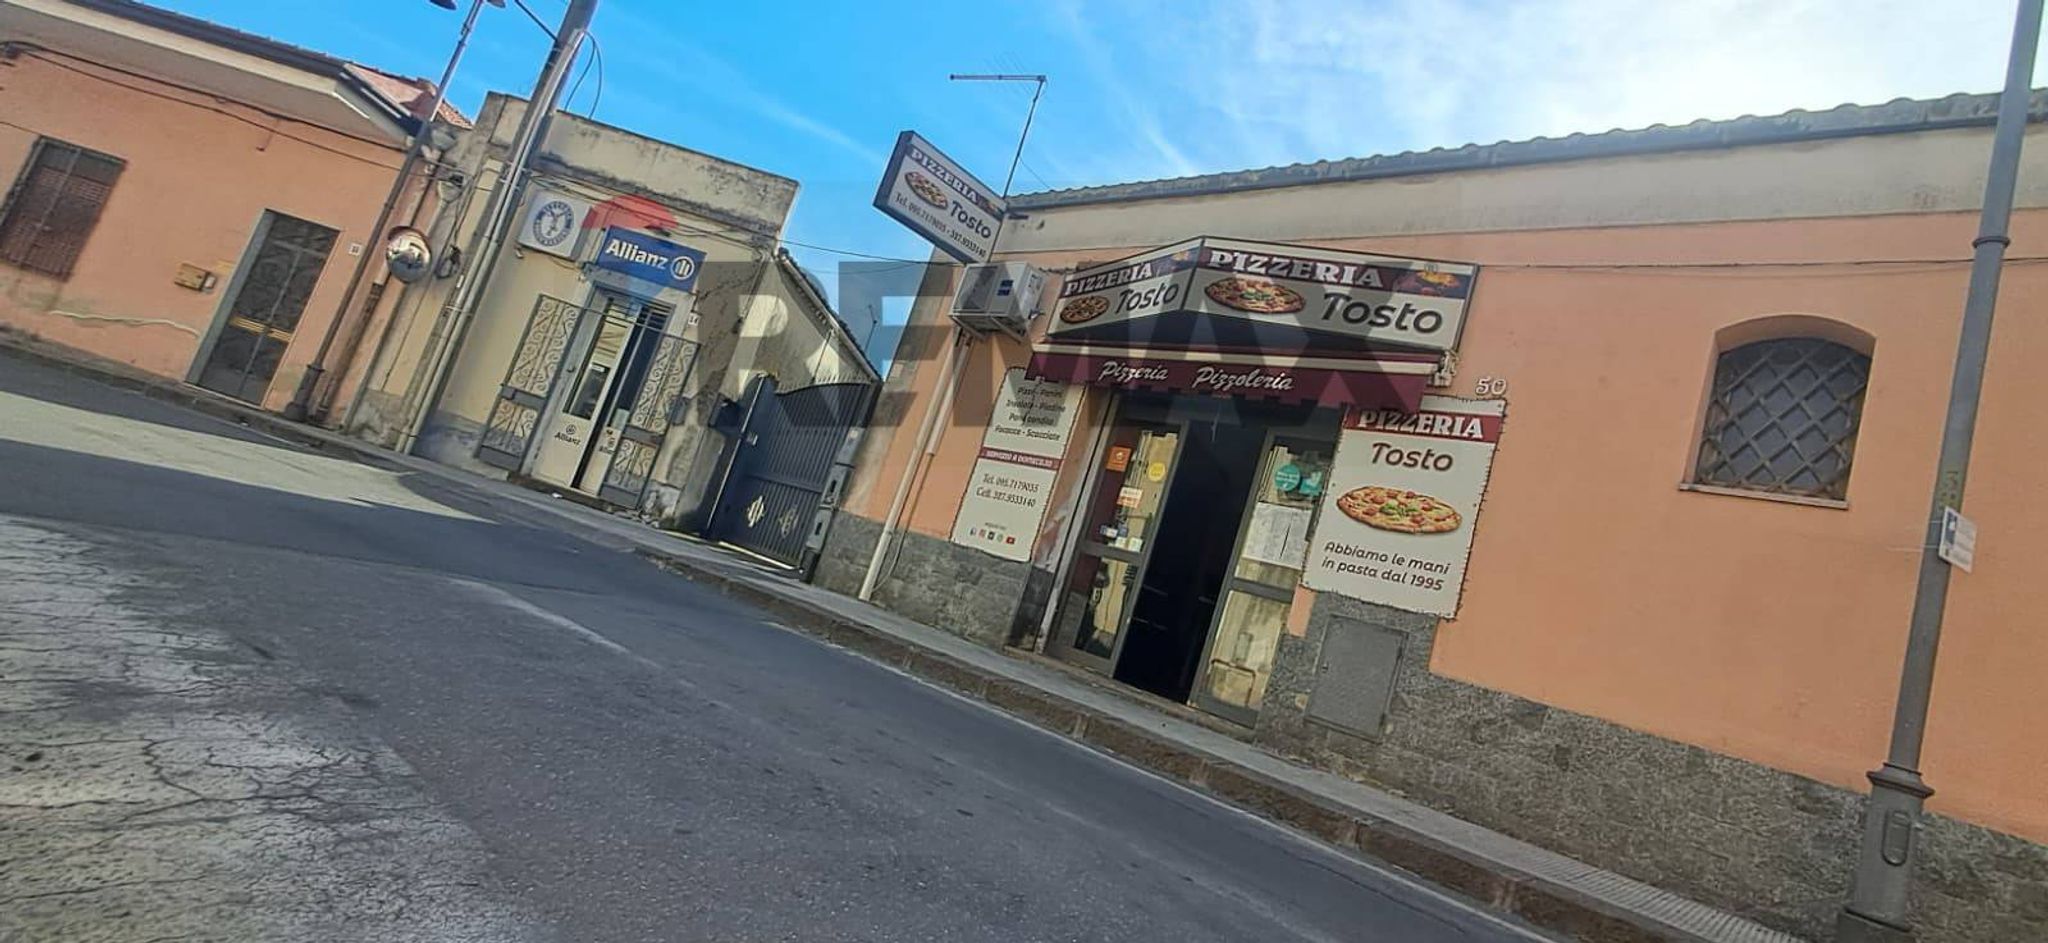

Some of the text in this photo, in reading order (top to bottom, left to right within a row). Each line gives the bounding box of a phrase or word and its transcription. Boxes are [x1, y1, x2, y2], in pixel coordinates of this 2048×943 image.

[911, 148, 979, 205] PIZZERIA
[950, 201, 991, 239] Tosto
[605, 238, 668, 270] Allianz
[1208, 250, 1384, 289] PIZZERIA
[1064, 262, 1153, 296] PIZZERIA
[1115, 282, 1180, 314] Tosto
[1321, 291, 1443, 335] Tosto
[1098, 360, 1295, 391] Pizzeria Pizzoleria
[1475, 376, 1507, 396] 50
[1358, 410, 1484, 438] PIZZERIA
[1372, 442, 1453, 471] Tosto
[1321, 556, 1445, 591] in pasta dal 1995
[1324, 541, 1452, 575] Abbiamo le mani
